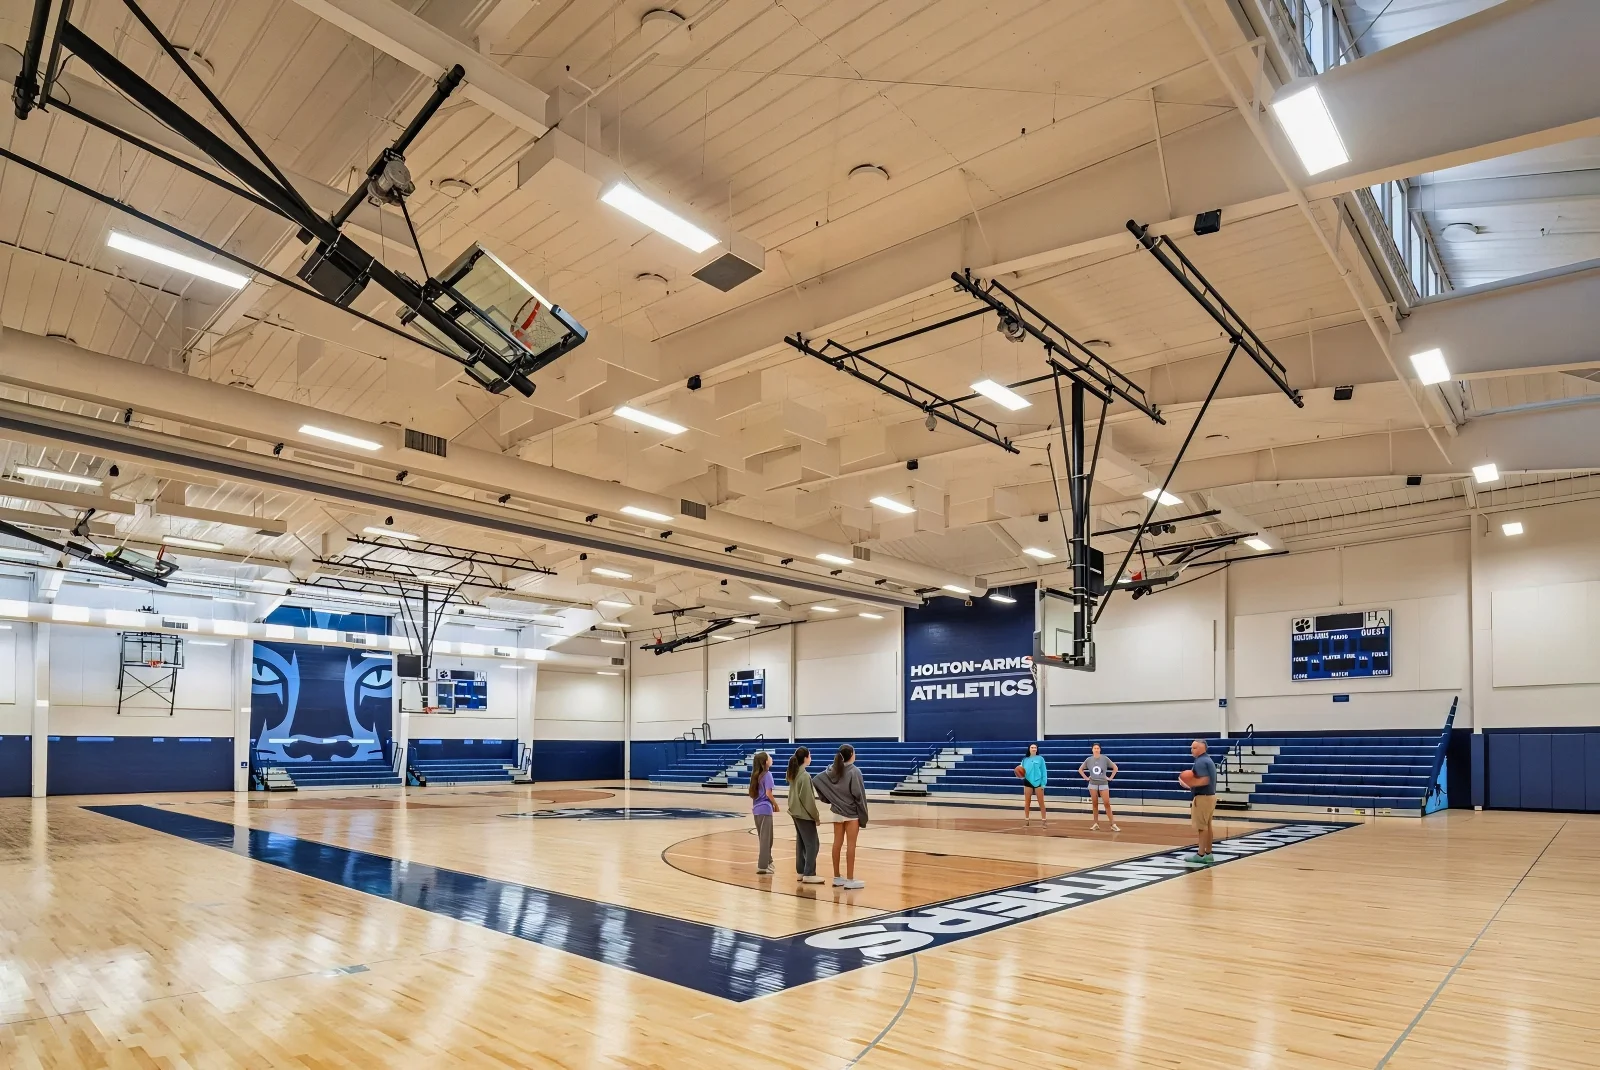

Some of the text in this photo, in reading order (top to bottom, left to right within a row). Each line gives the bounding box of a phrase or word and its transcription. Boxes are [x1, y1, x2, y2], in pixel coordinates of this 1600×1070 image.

[1361, 627, 1386, 637] GUEST
[910, 656, 1033, 676] HOLTON-ARMS
[910, 679, 1034, 701] ATHLETICS
